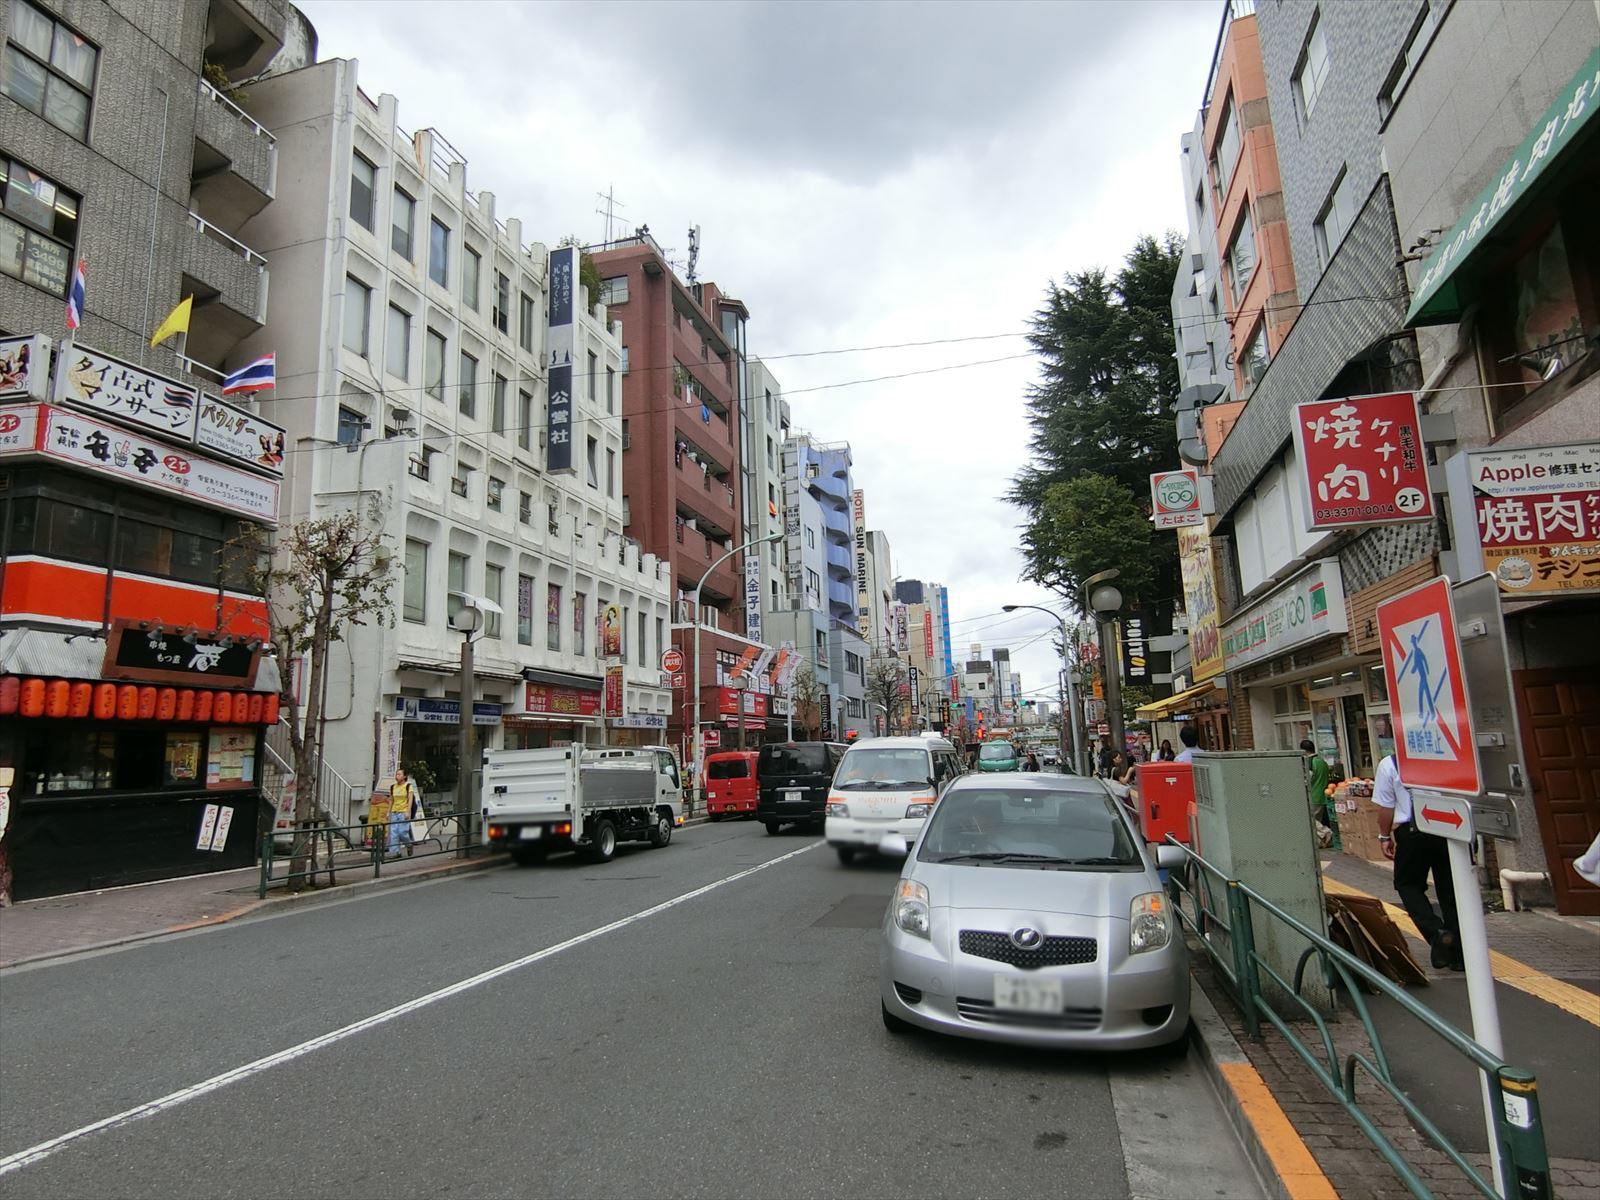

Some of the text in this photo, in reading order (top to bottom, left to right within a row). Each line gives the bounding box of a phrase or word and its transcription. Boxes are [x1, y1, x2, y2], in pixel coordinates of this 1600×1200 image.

[76, 356, 155, 399] タイ古式
[80, 381, 191, 428] マッサージ
[551, 390, 569, 445] 公営社
[1306, 403, 1370, 502] 焼肉
[1371, 418, 1399, 486] ケナリ
[1399, 425, 1417, 473] 黒毛和牛
[1162, 490, 1193, 504] 100
[1480, 464, 1546, 483] Apple
[1161, 514, 1197, 525] たばこ
[1398, 493, 1421, 508] 2F
[1478, 495, 1585, 543] 焼肉
[853, 490, 867, 595] HOTEL SUN MARINE
[747, 578, 760, 642] 金子建設
